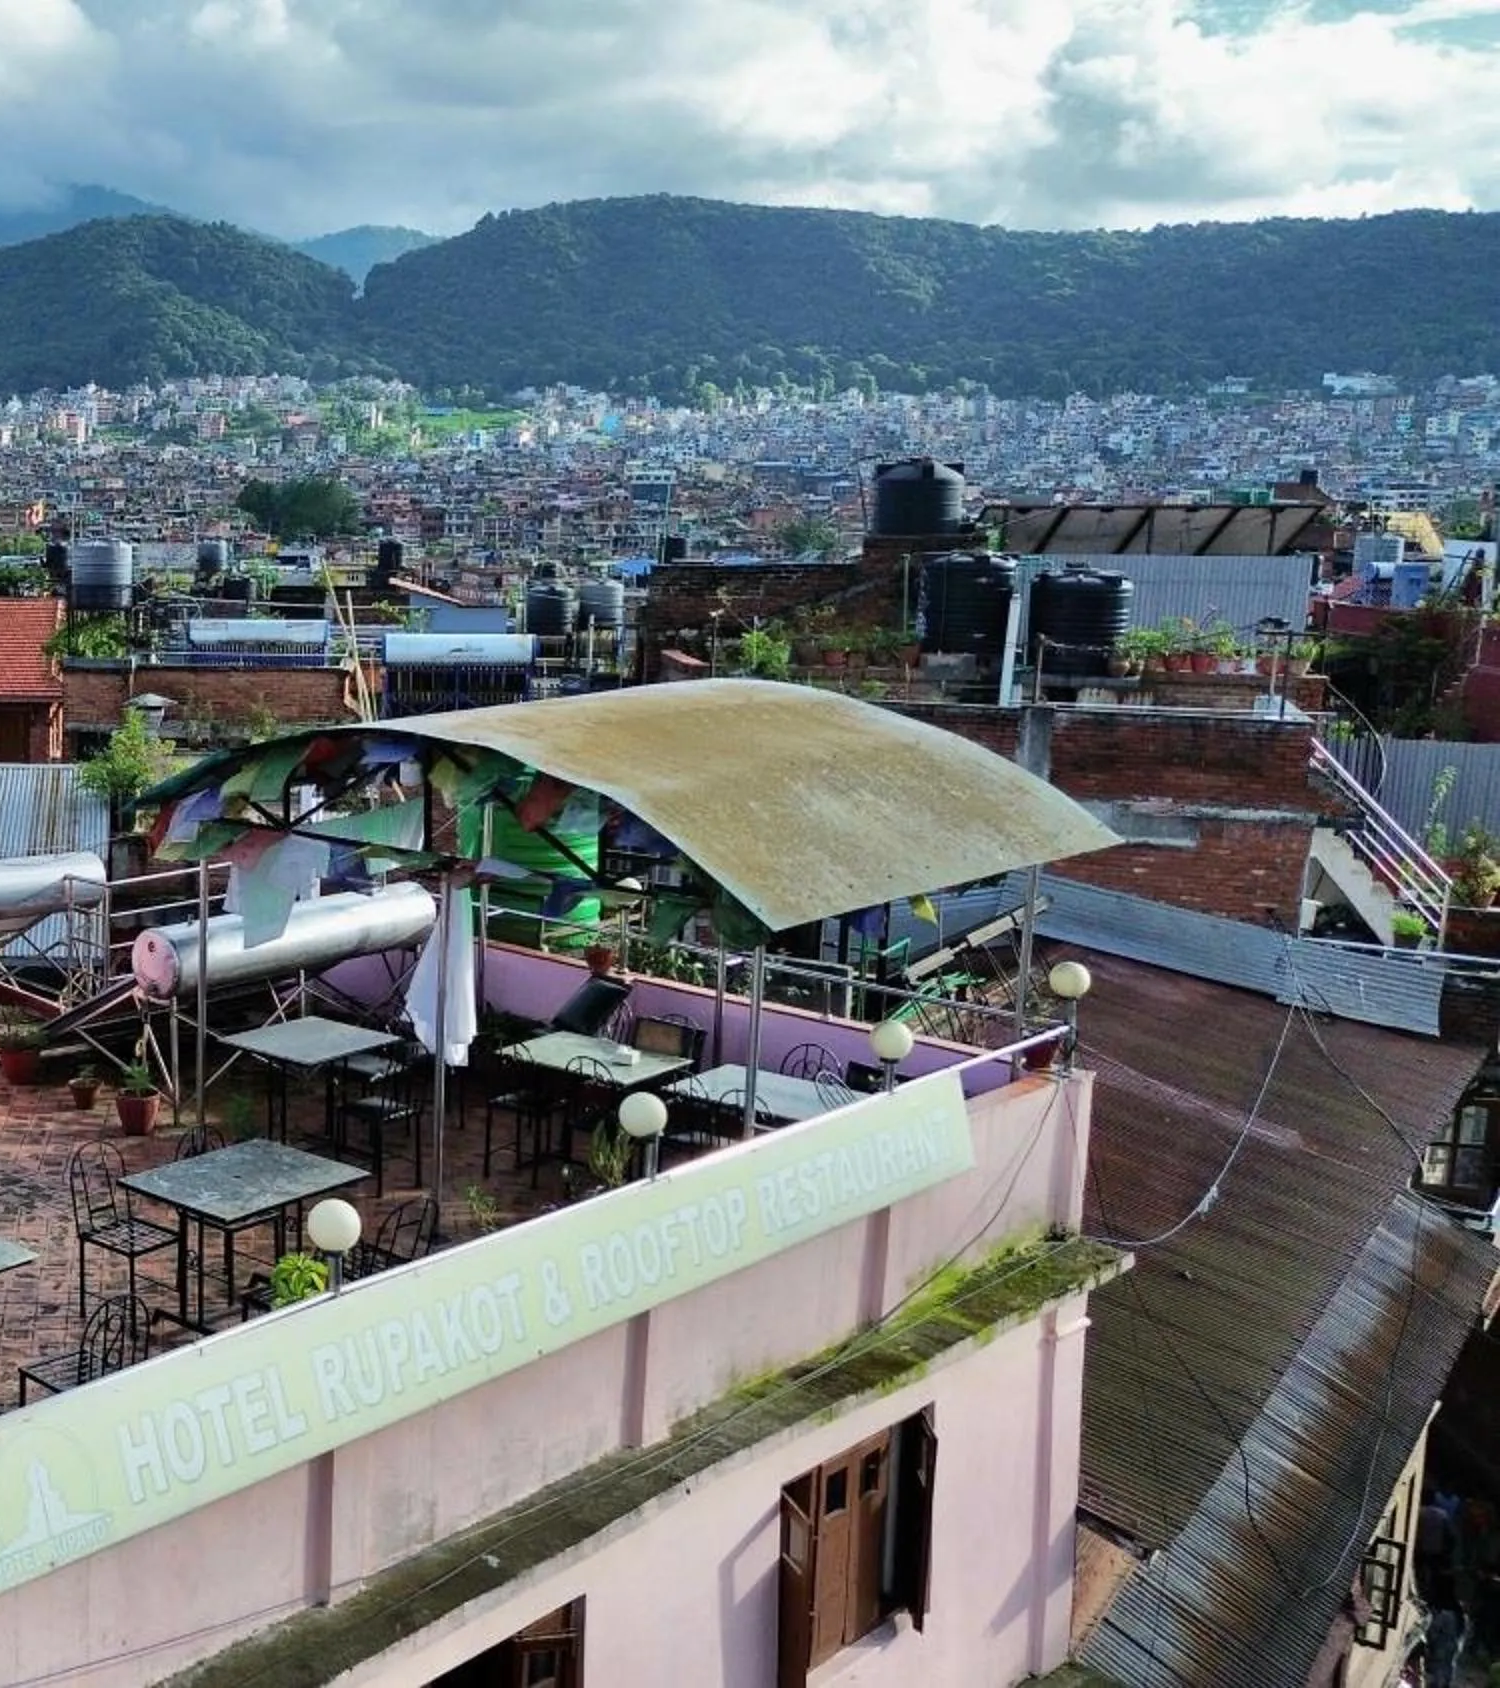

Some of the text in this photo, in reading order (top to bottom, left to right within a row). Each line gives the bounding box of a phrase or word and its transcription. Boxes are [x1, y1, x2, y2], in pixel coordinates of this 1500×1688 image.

[116, 1107, 952, 1504] HOTEL RUPAKOT & ROOFTOP RESTAURANT
